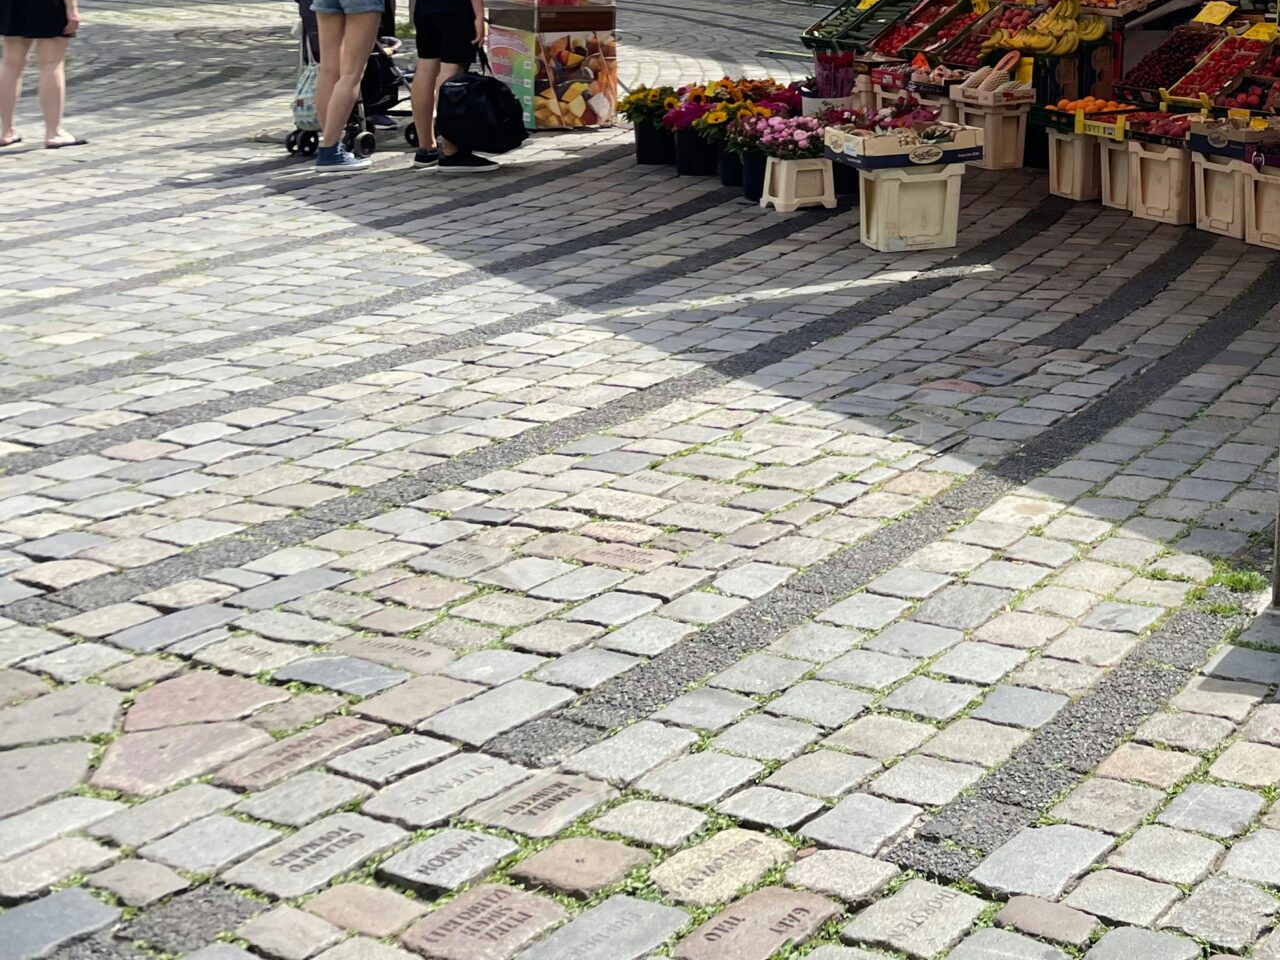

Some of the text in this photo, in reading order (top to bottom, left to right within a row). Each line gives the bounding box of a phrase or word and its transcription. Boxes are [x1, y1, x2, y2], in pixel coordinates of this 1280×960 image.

[365, 740, 426, 766] HORST
[427, 765, 495, 799] STEFAN
[521, 786, 582, 817] DANIELA
[415, 835, 486, 877] MARION
[769, 906, 811, 936] GABY
[886, 888, 960, 945] THORSTEN
